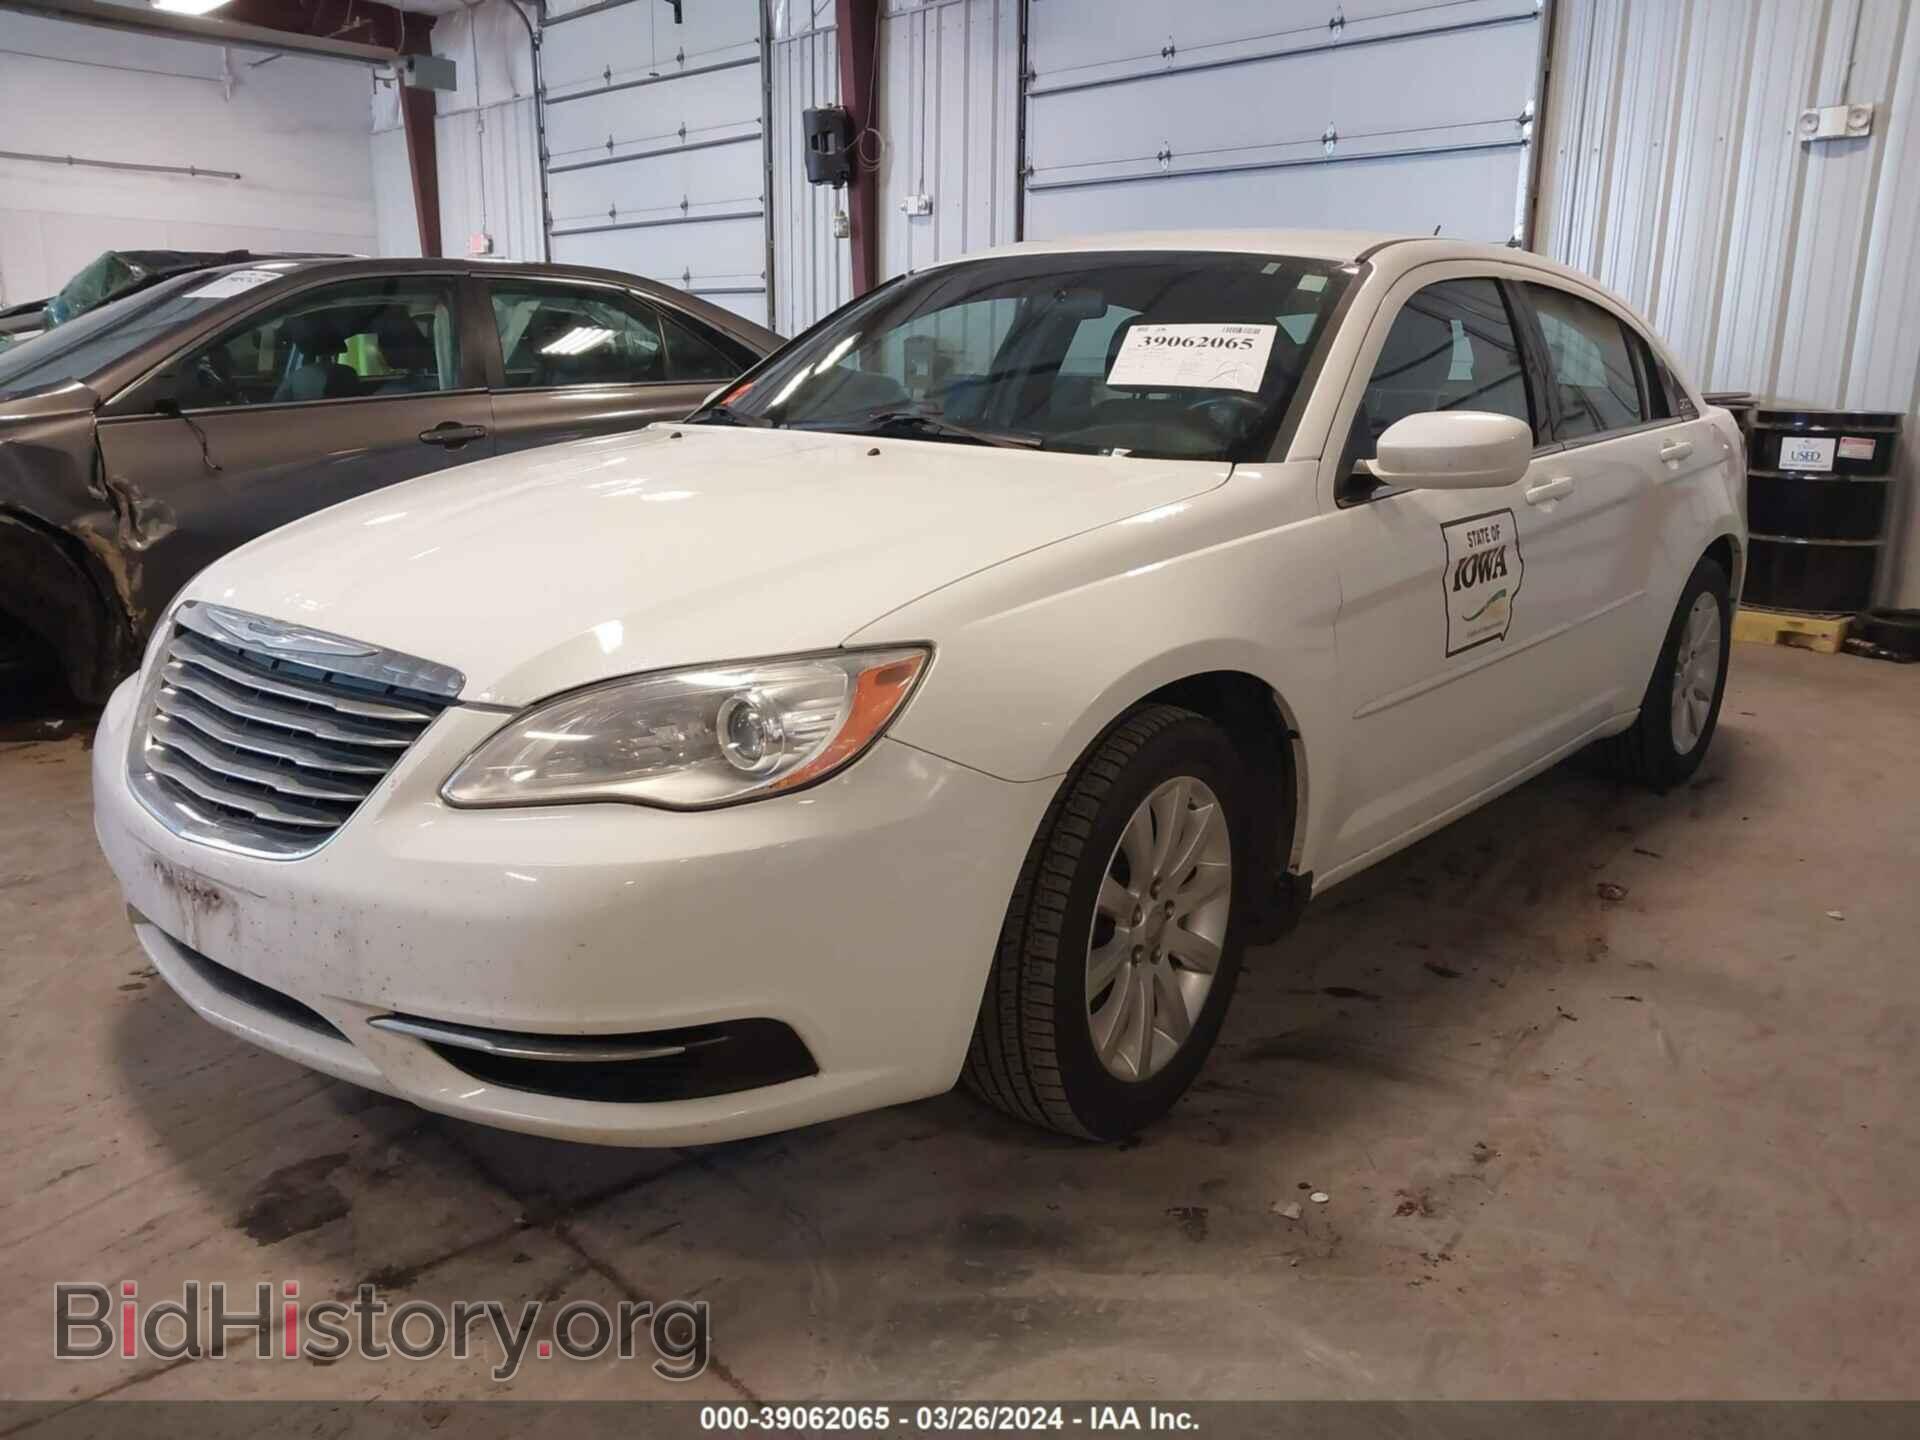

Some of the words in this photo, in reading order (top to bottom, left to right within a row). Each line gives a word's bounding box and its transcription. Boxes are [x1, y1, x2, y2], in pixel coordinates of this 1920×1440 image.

[1138, 335, 1254, 350] 39062065
[1791, 450, 1821, 461] USED
[1467, 527, 1490, 548] STATE
[1491, 524, 1501, 541] OF
[1453, 545, 1508, 592] IOWA
